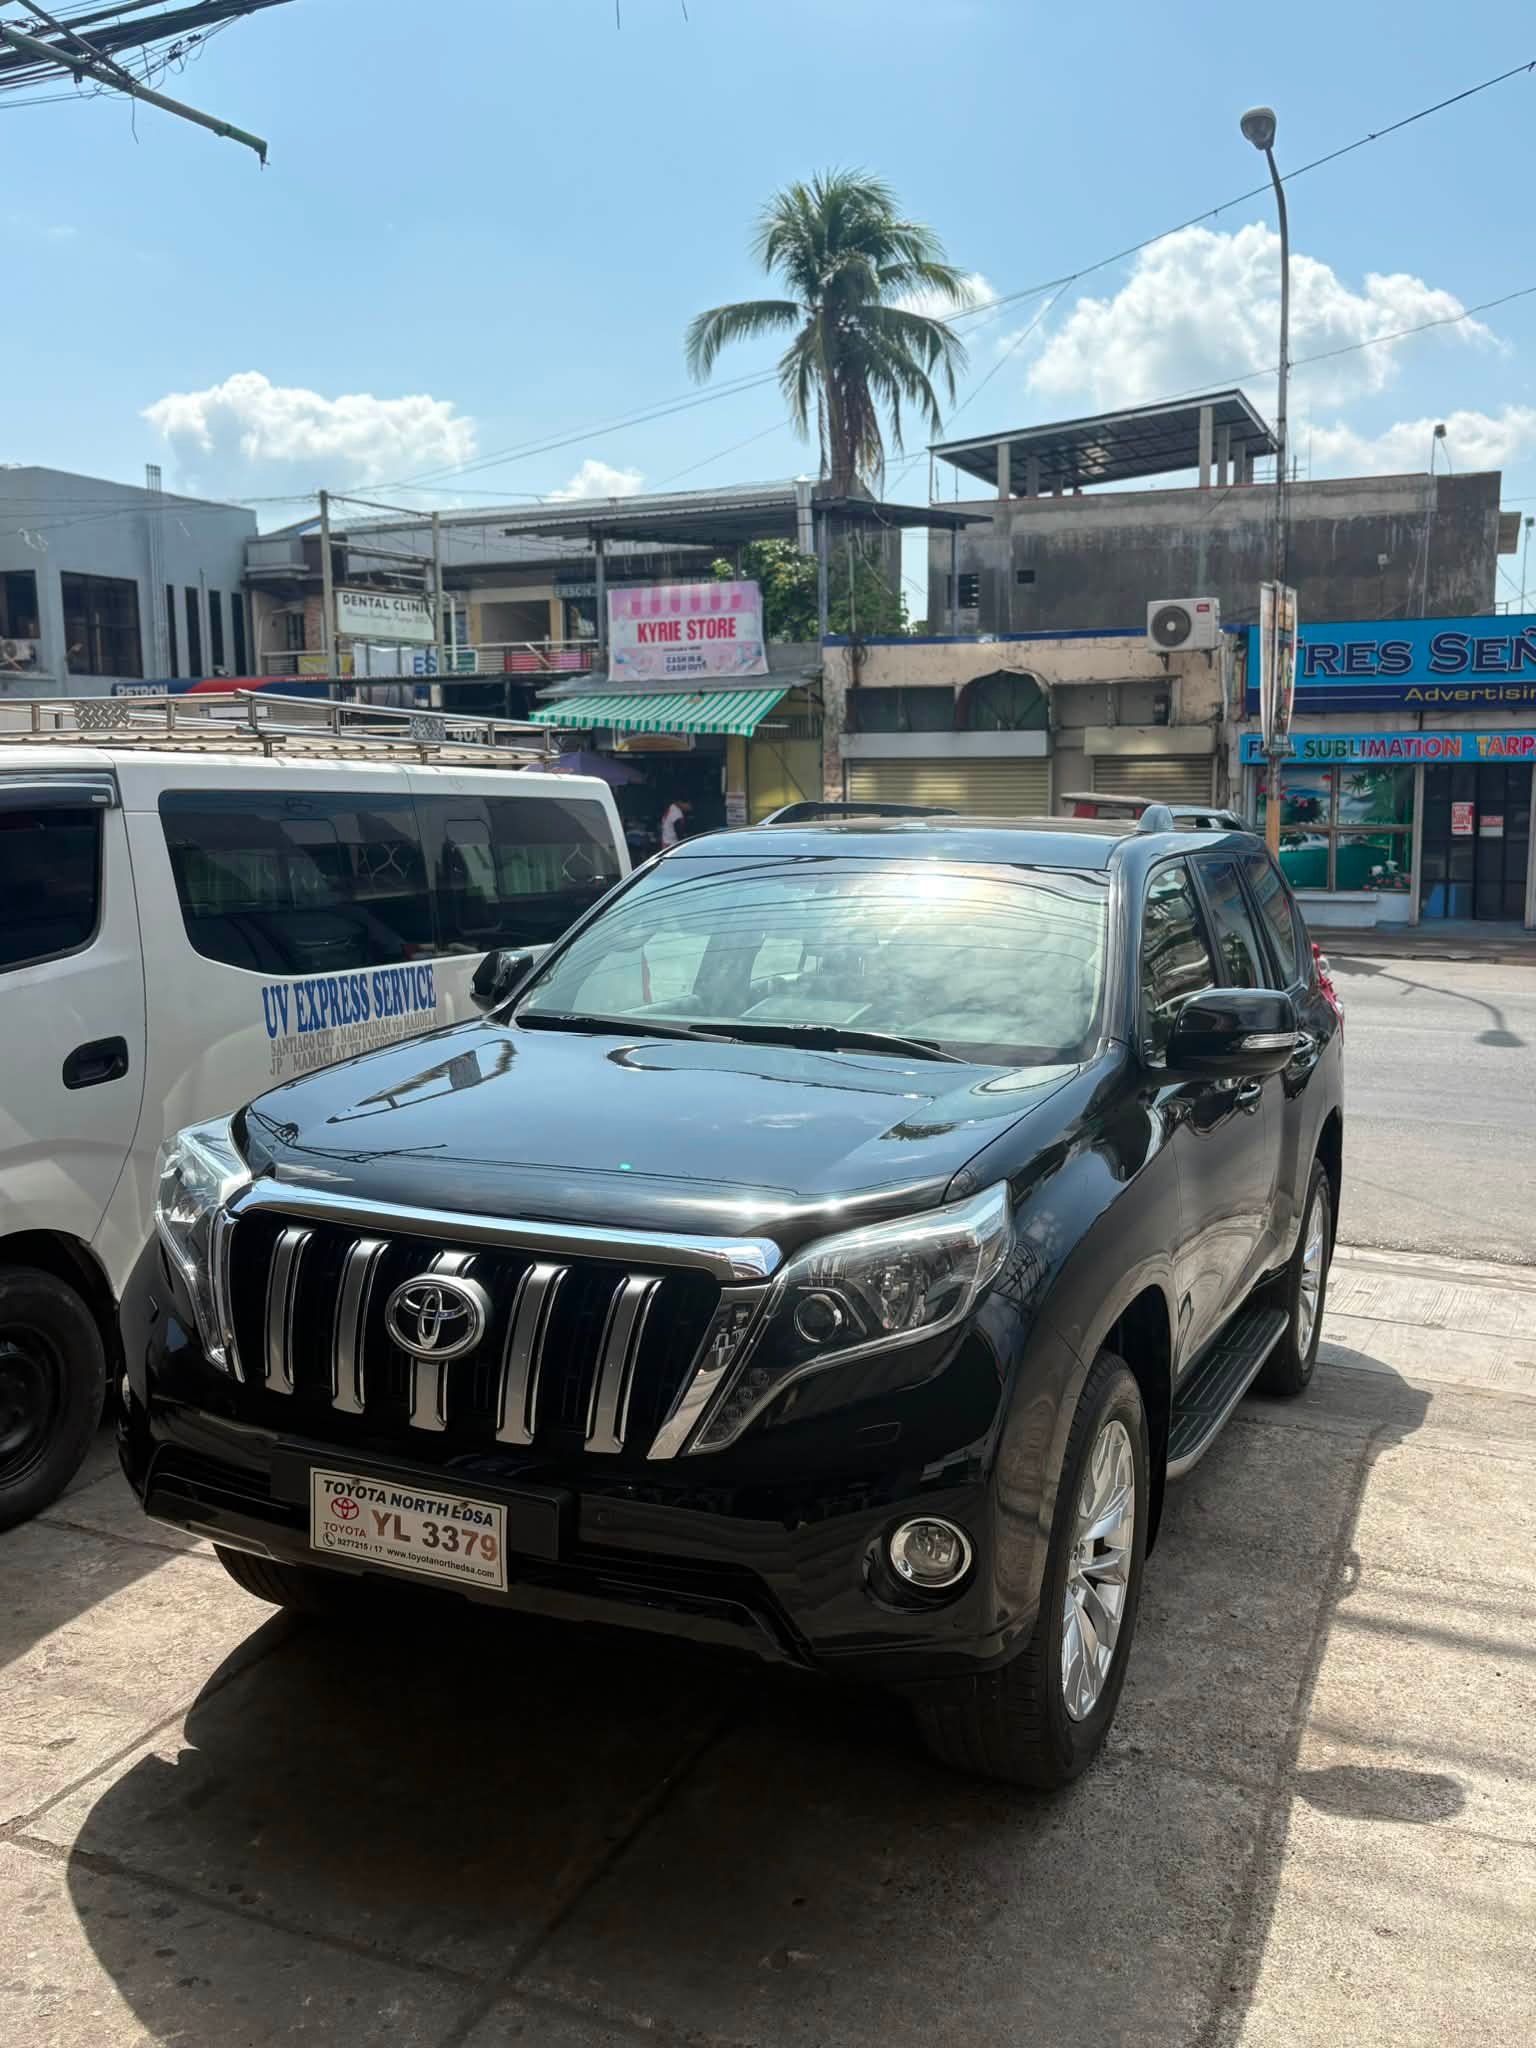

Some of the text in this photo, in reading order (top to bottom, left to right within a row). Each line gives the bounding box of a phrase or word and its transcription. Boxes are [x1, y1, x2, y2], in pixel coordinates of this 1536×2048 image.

[343, 595, 390, 609] DENTAL
[637, 617, 736, 643] KYRIE STORE
[1295, 635, 1413, 676] RES
[115, 684, 168, 696] PETRON
[1304, 735, 1461, 758] SUBLIMATION
[1476, 735, 1536, 757] TARP
[262, 963, 437, 1039] UV EXPRESS SERVICE
[270, 1056, 284, 1076] JP
[323, 1479, 494, 1527] TOYOTA NORTH EDSA
[323, 1521, 367, 1539] TOYOTA
[371, 1508, 498, 1562] YL 3379
[337, 1536, 369, 1551] 9277215
[386, 1547, 495, 1579] www.toyotanorthedsa.com
